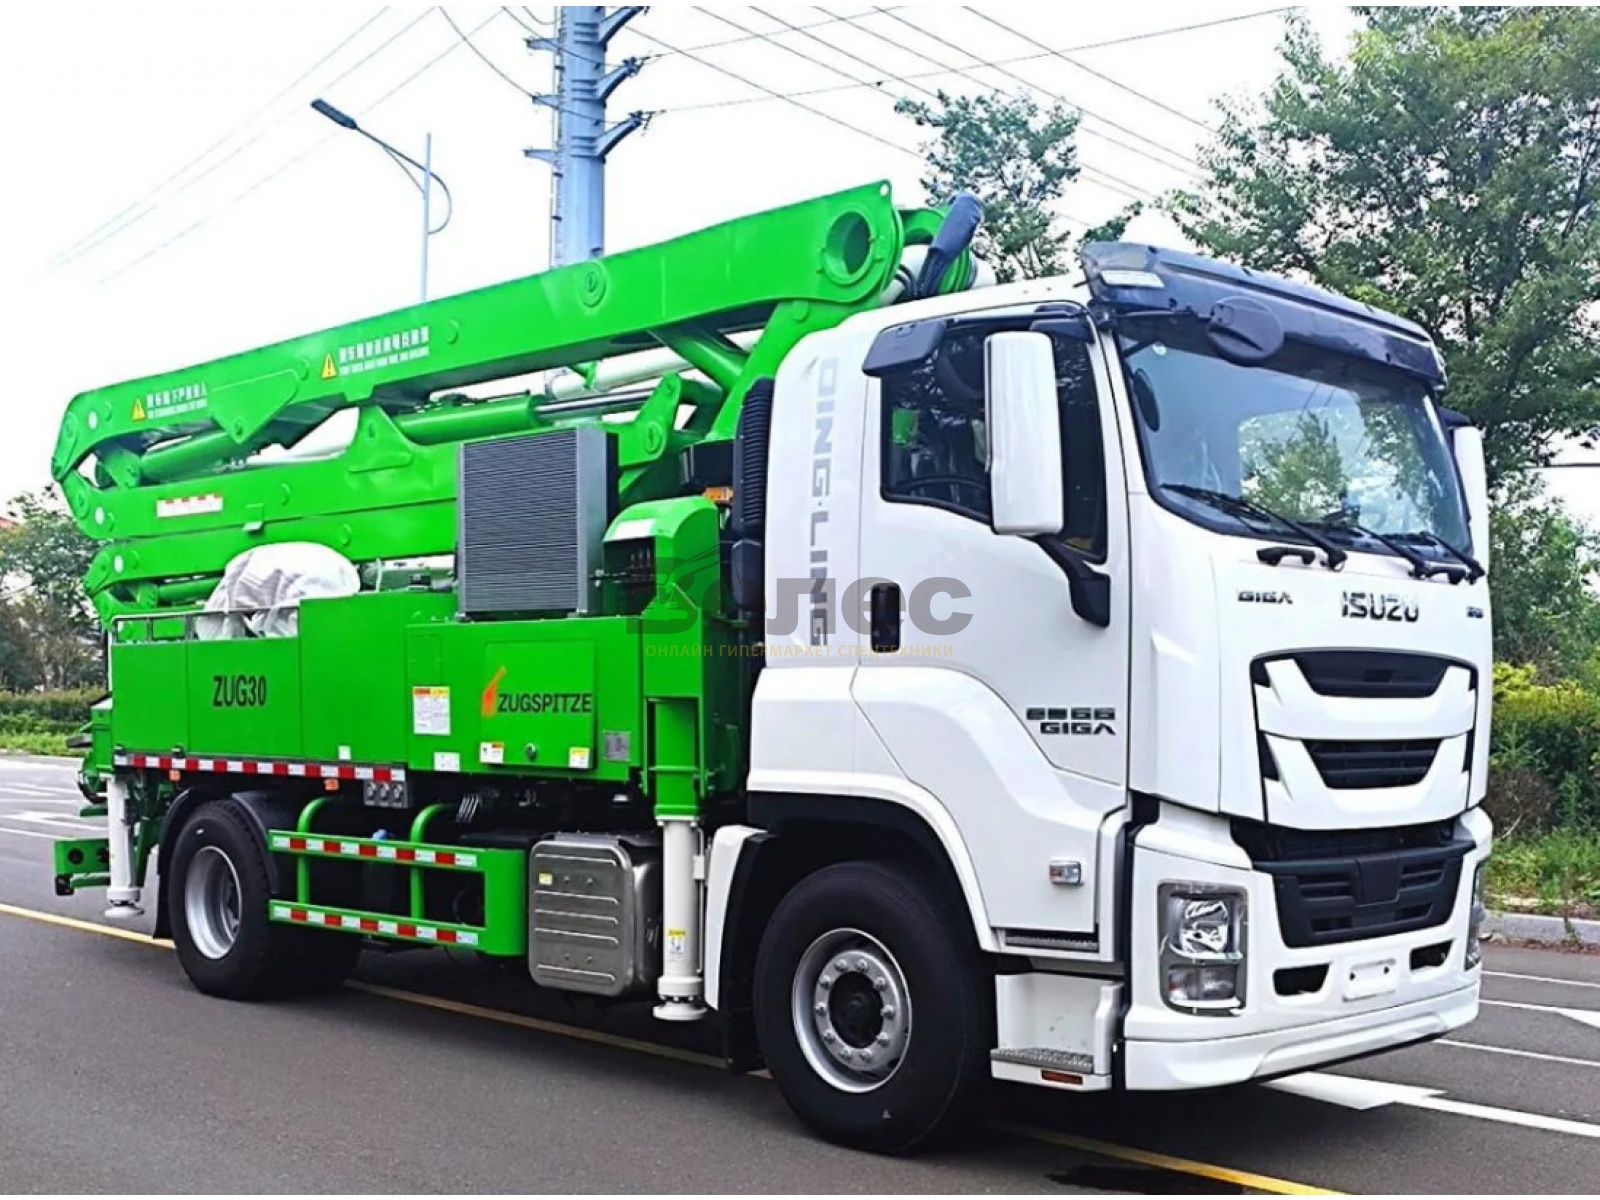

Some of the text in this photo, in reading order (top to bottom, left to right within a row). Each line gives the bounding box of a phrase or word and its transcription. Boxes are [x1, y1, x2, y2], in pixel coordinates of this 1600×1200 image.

[1237, 590, 1293, 605] GIGA
[1341, 590, 1420, 623] ISUZU
[212, 674, 267, 707] ZUG30
[498, 692, 593, 713] ZUGSPITZE
[1040, 722, 1116, 736] GIGA
